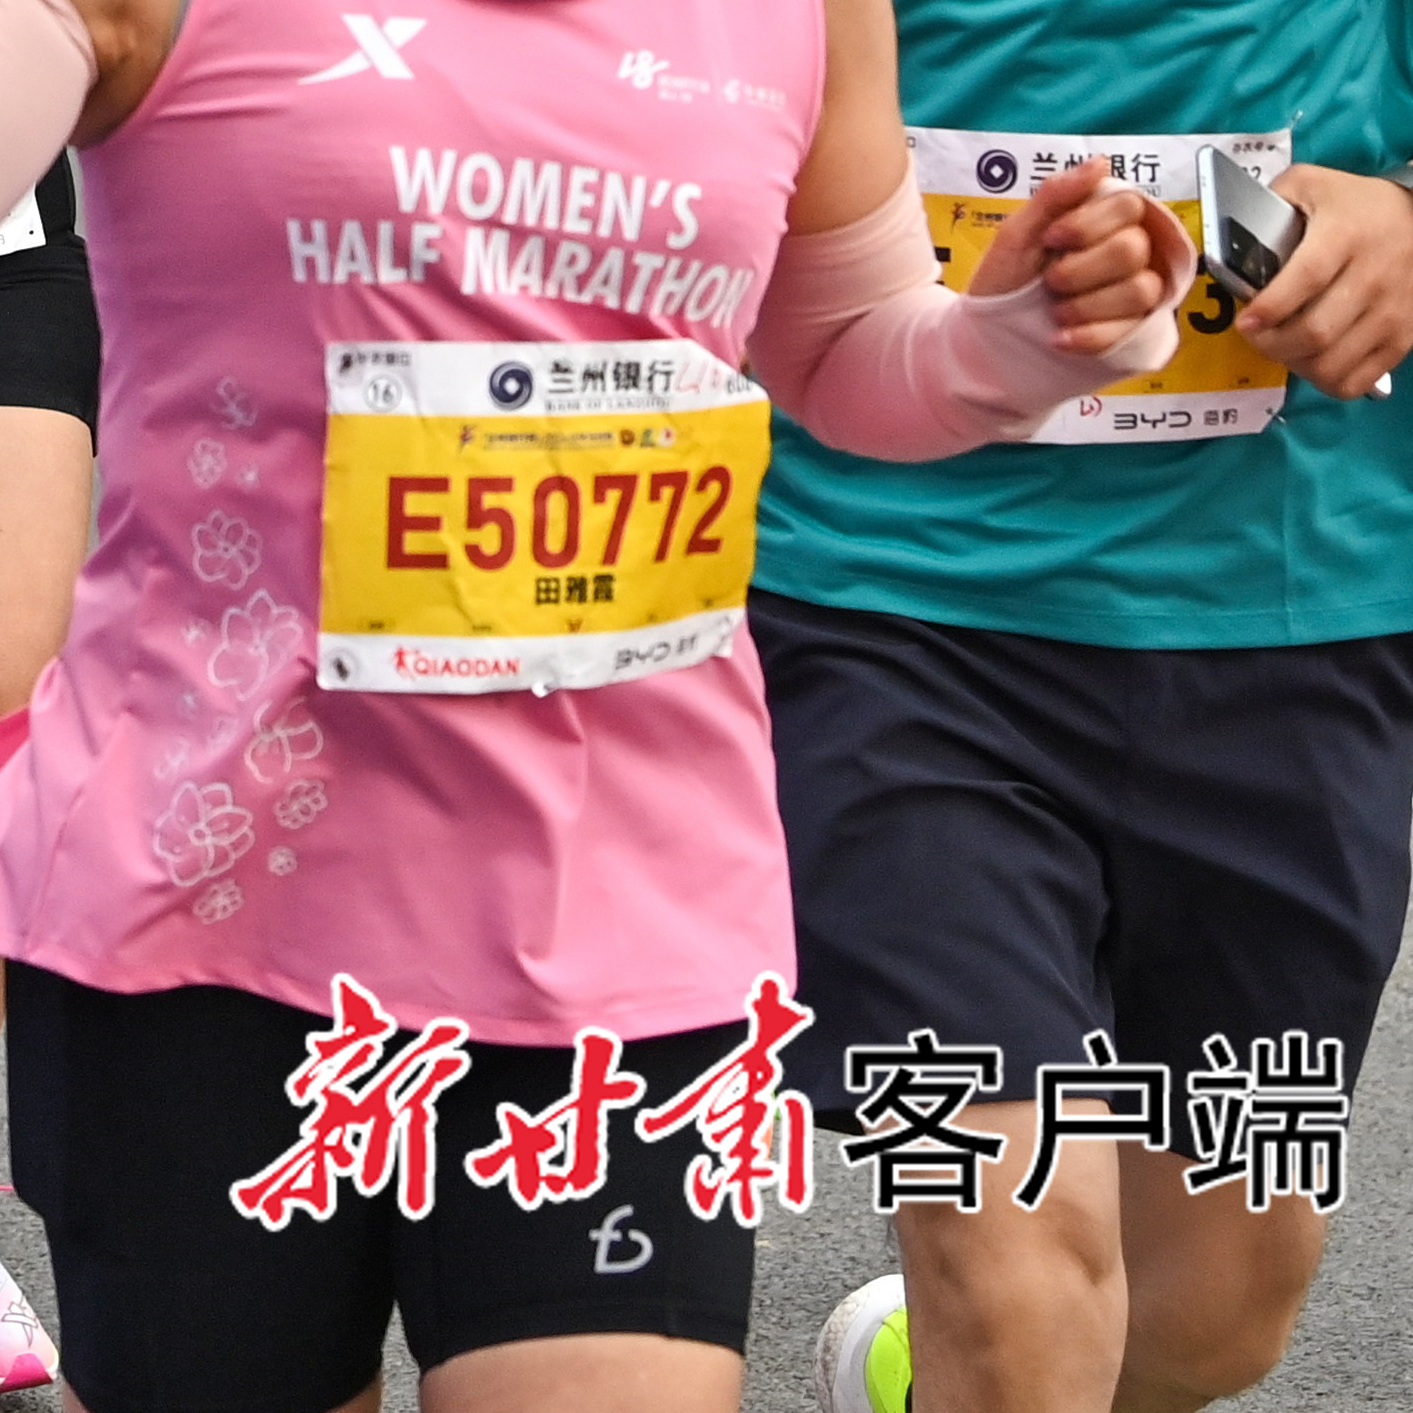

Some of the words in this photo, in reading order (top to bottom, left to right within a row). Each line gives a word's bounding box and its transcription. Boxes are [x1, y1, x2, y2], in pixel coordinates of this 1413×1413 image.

[388, 144, 703, 250] WOMEN'S
[286, 217, 445, 285] HALF
[460, 225, 756, 330] MARATHON
[547, 360, 676, 395] 兰州银行
[1113, 411, 1192, 430] BYD
[386, 465, 732, 570] E50772
[535, 573, 617, 606] 田雅霞
[415, 655, 521, 676] QIAODAN
